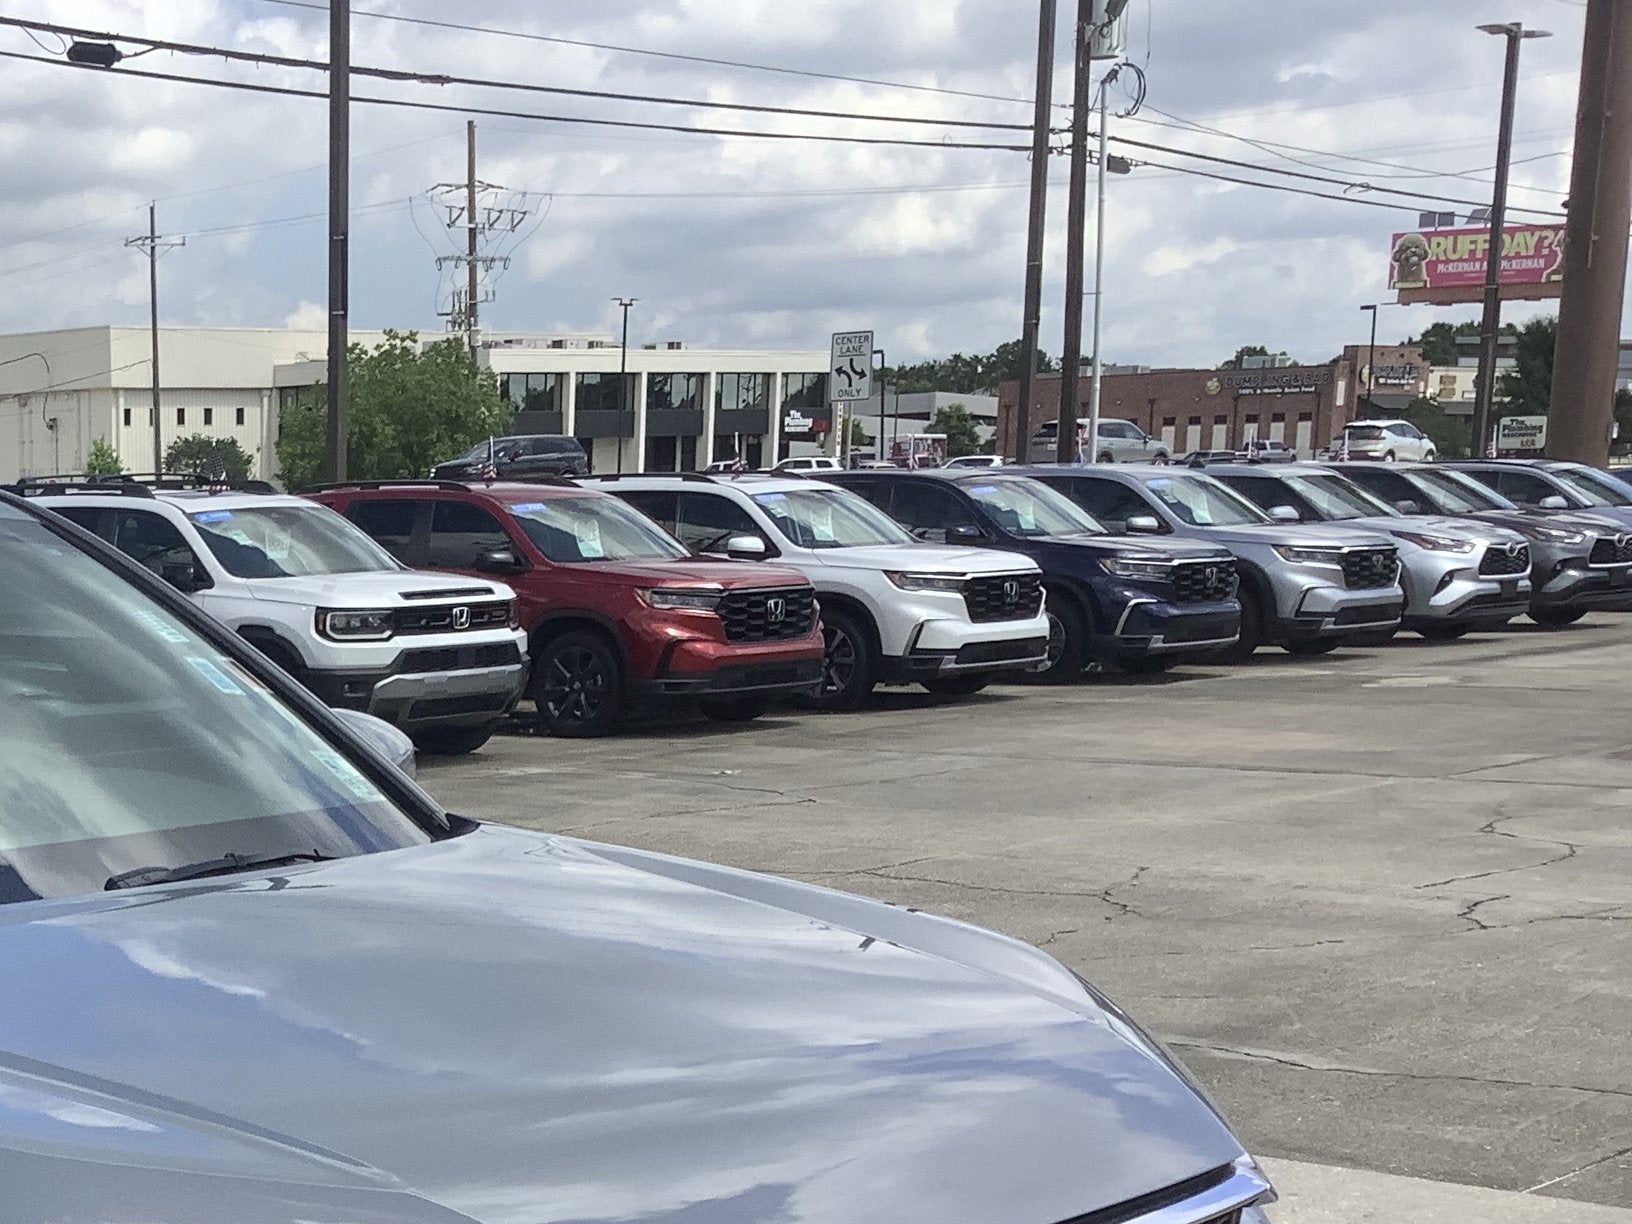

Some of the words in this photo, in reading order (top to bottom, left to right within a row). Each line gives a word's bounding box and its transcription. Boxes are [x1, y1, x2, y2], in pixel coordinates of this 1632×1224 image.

[1430, 234, 1490, 260] RUFF
[835, 335, 869, 345] CENTER
[840, 345, 863, 354] LANE
[838, 388, 862, 397] ONLY
